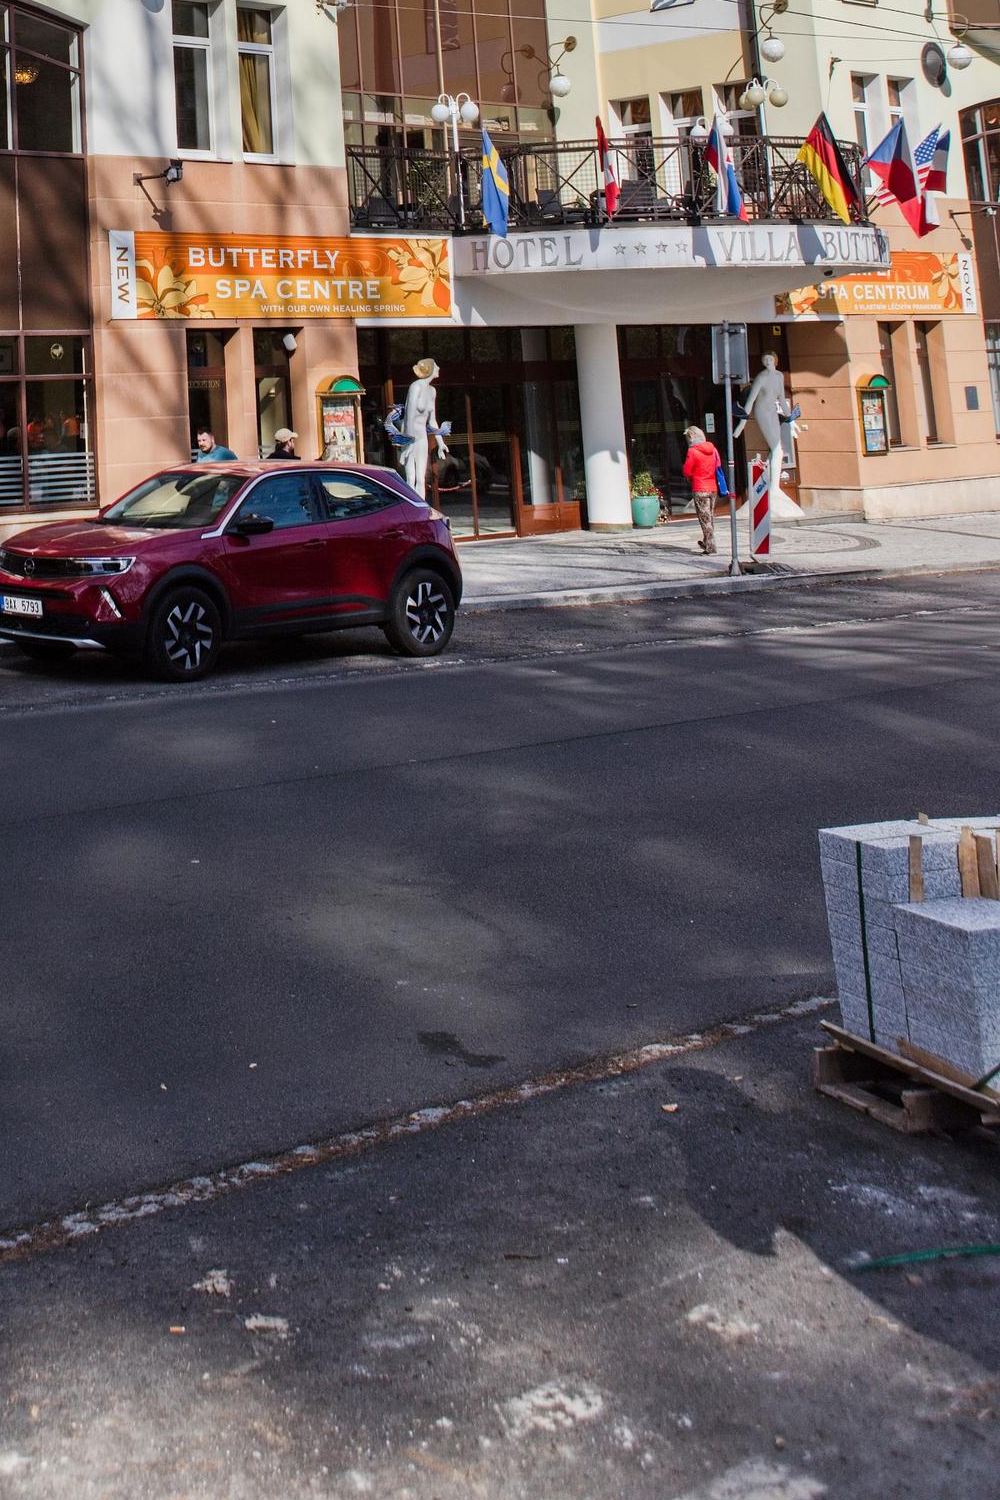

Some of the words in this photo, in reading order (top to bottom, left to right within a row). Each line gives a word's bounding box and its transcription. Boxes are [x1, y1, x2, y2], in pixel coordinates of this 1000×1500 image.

[187, 247, 341, 270] BUTTERFLY
[471, 235, 584, 271] HOTEL
[716, 230, 803, 263] VILLA
[115, 246, 130, 304] NEW
[215, 279, 268, 300] SPA
[275, 279, 382, 300] CENTRE
[817, 284, 849, 300] SPA
[852, 284, 930, 300] CENTRUM
[260, 305, 285, 313] WITH
[287, 305, 307, 313] OUR
[309, 305, 330, 313] OWN
[333, 305, 372, 313] HEALING
[374, 304, 406, 312] SPRING
[21, 600, 40, 613] 5793
